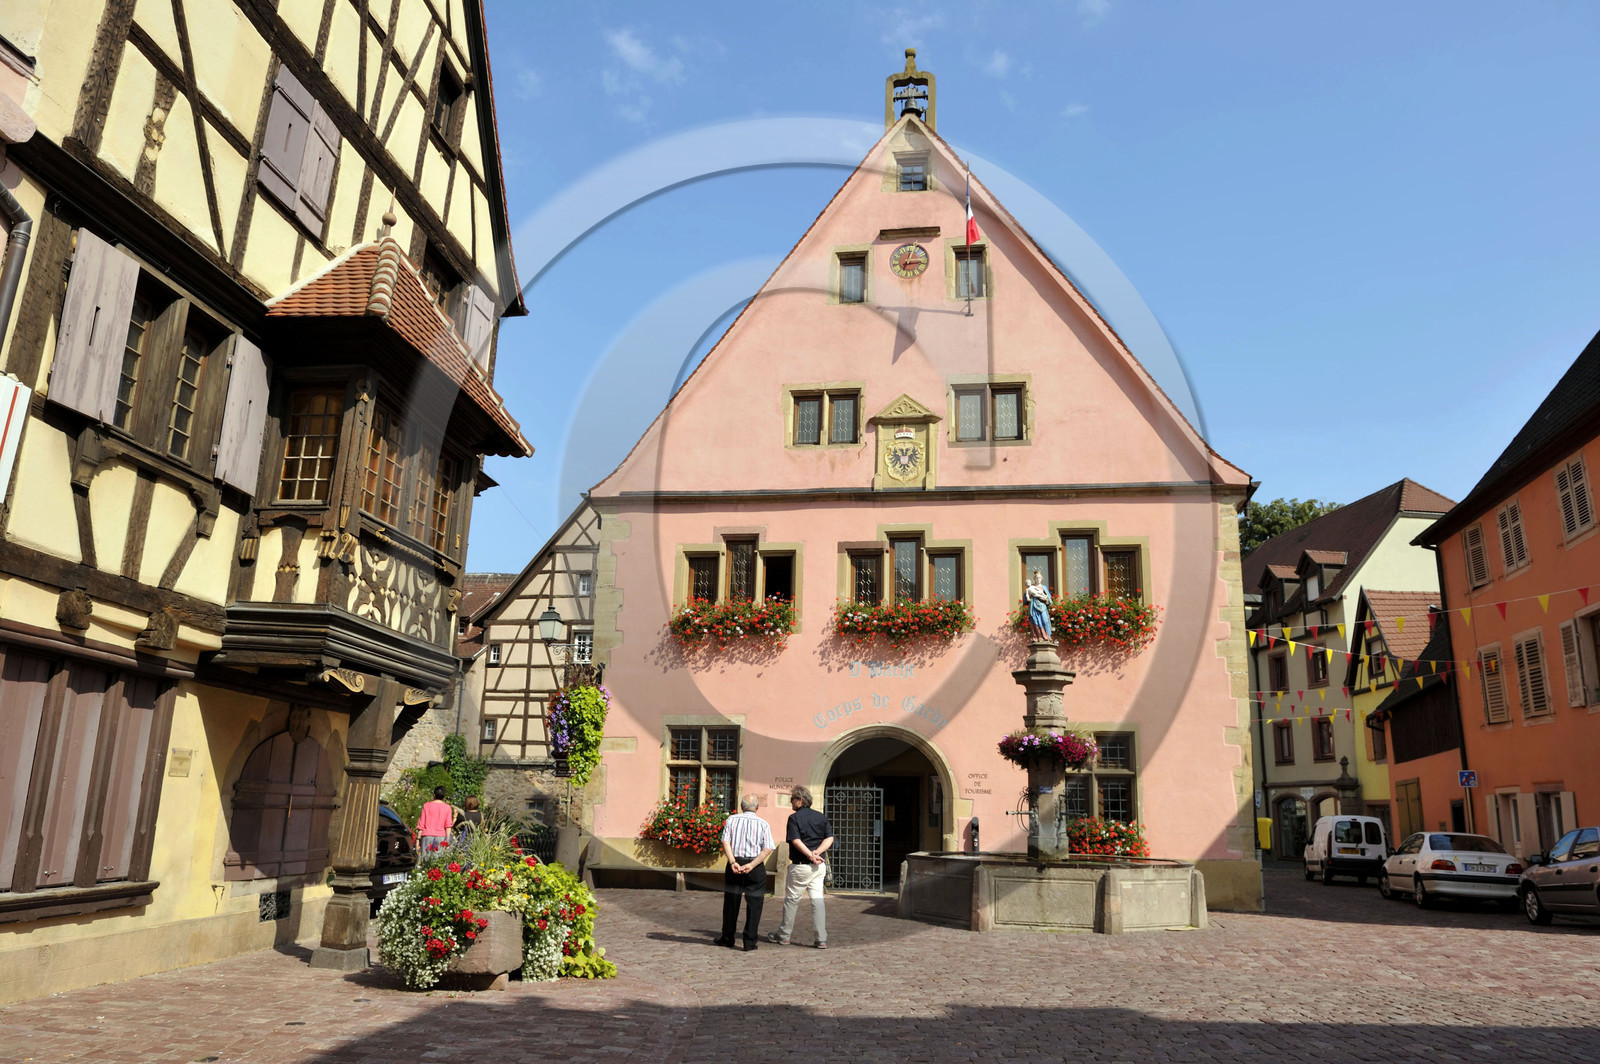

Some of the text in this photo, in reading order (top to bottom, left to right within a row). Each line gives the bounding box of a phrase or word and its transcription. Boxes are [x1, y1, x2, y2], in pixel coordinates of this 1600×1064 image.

[814, 692, 949, 730] Corps de Garde
